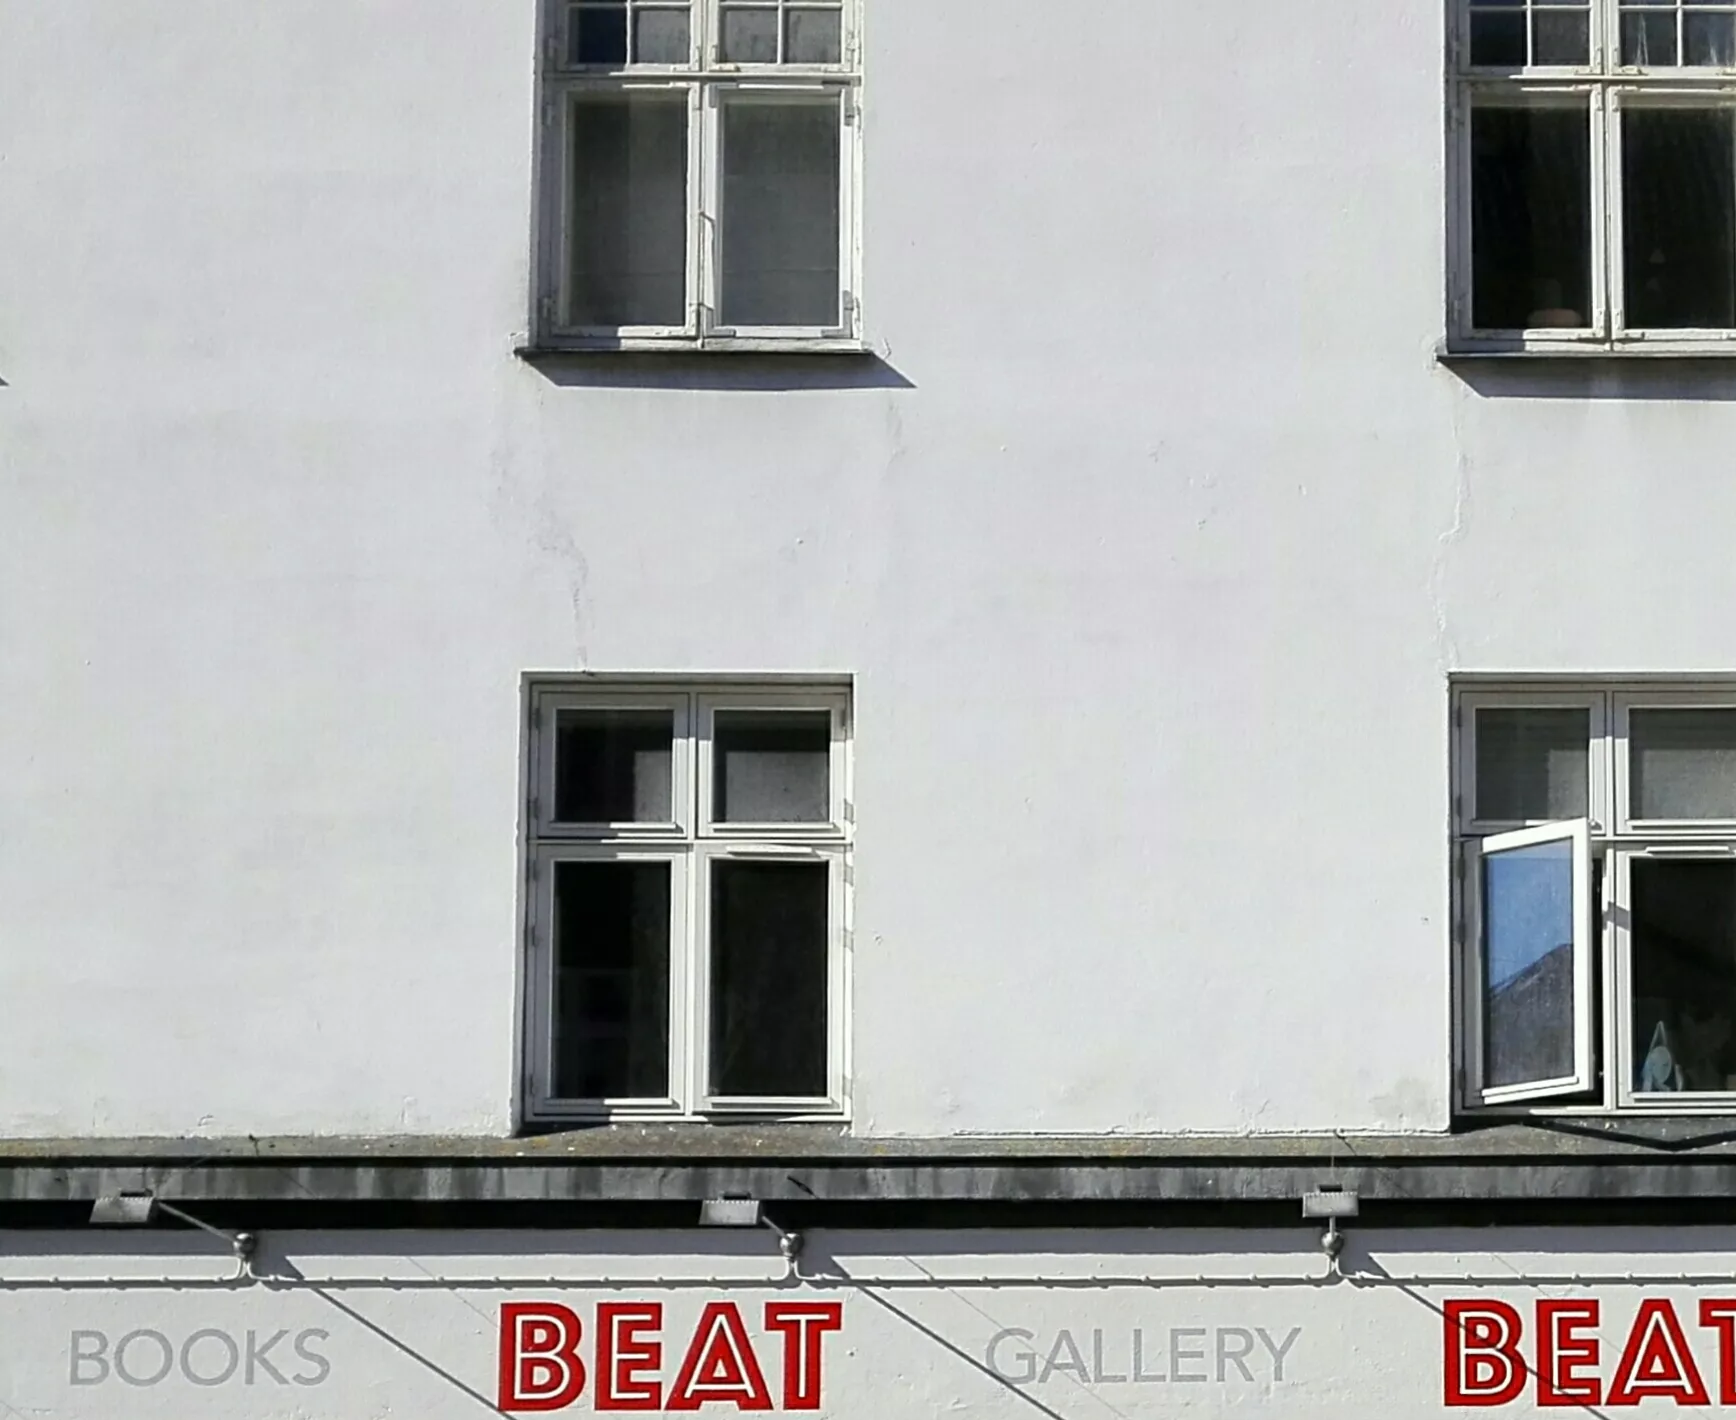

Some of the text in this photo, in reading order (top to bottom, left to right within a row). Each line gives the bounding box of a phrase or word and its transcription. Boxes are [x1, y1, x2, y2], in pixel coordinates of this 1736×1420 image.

[69, 1329, 330, 1387] BOOKS
[498, 1302, 842, 1411] BEAT
[986, 1327, 1302, 1384] GALLERY
